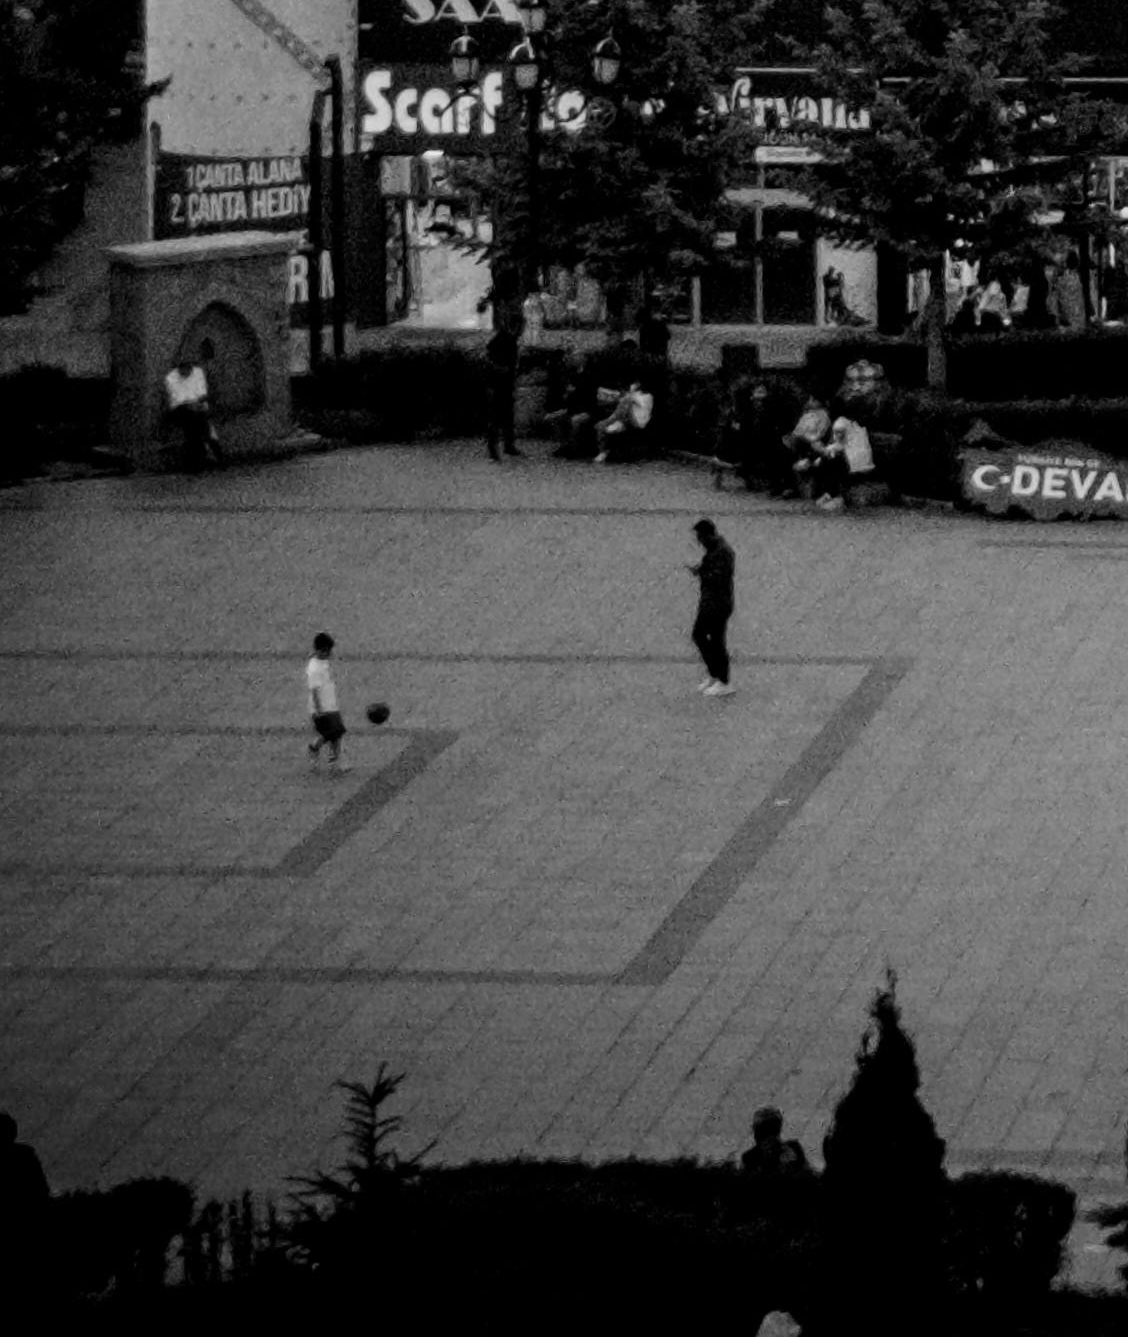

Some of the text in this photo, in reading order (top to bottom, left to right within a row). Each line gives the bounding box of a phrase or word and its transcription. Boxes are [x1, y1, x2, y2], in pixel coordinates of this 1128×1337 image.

[247, 157, 303, 186] ALANA
[170, 193, 185, 224] 2
[251, 184, 312, 219] HEDİY
